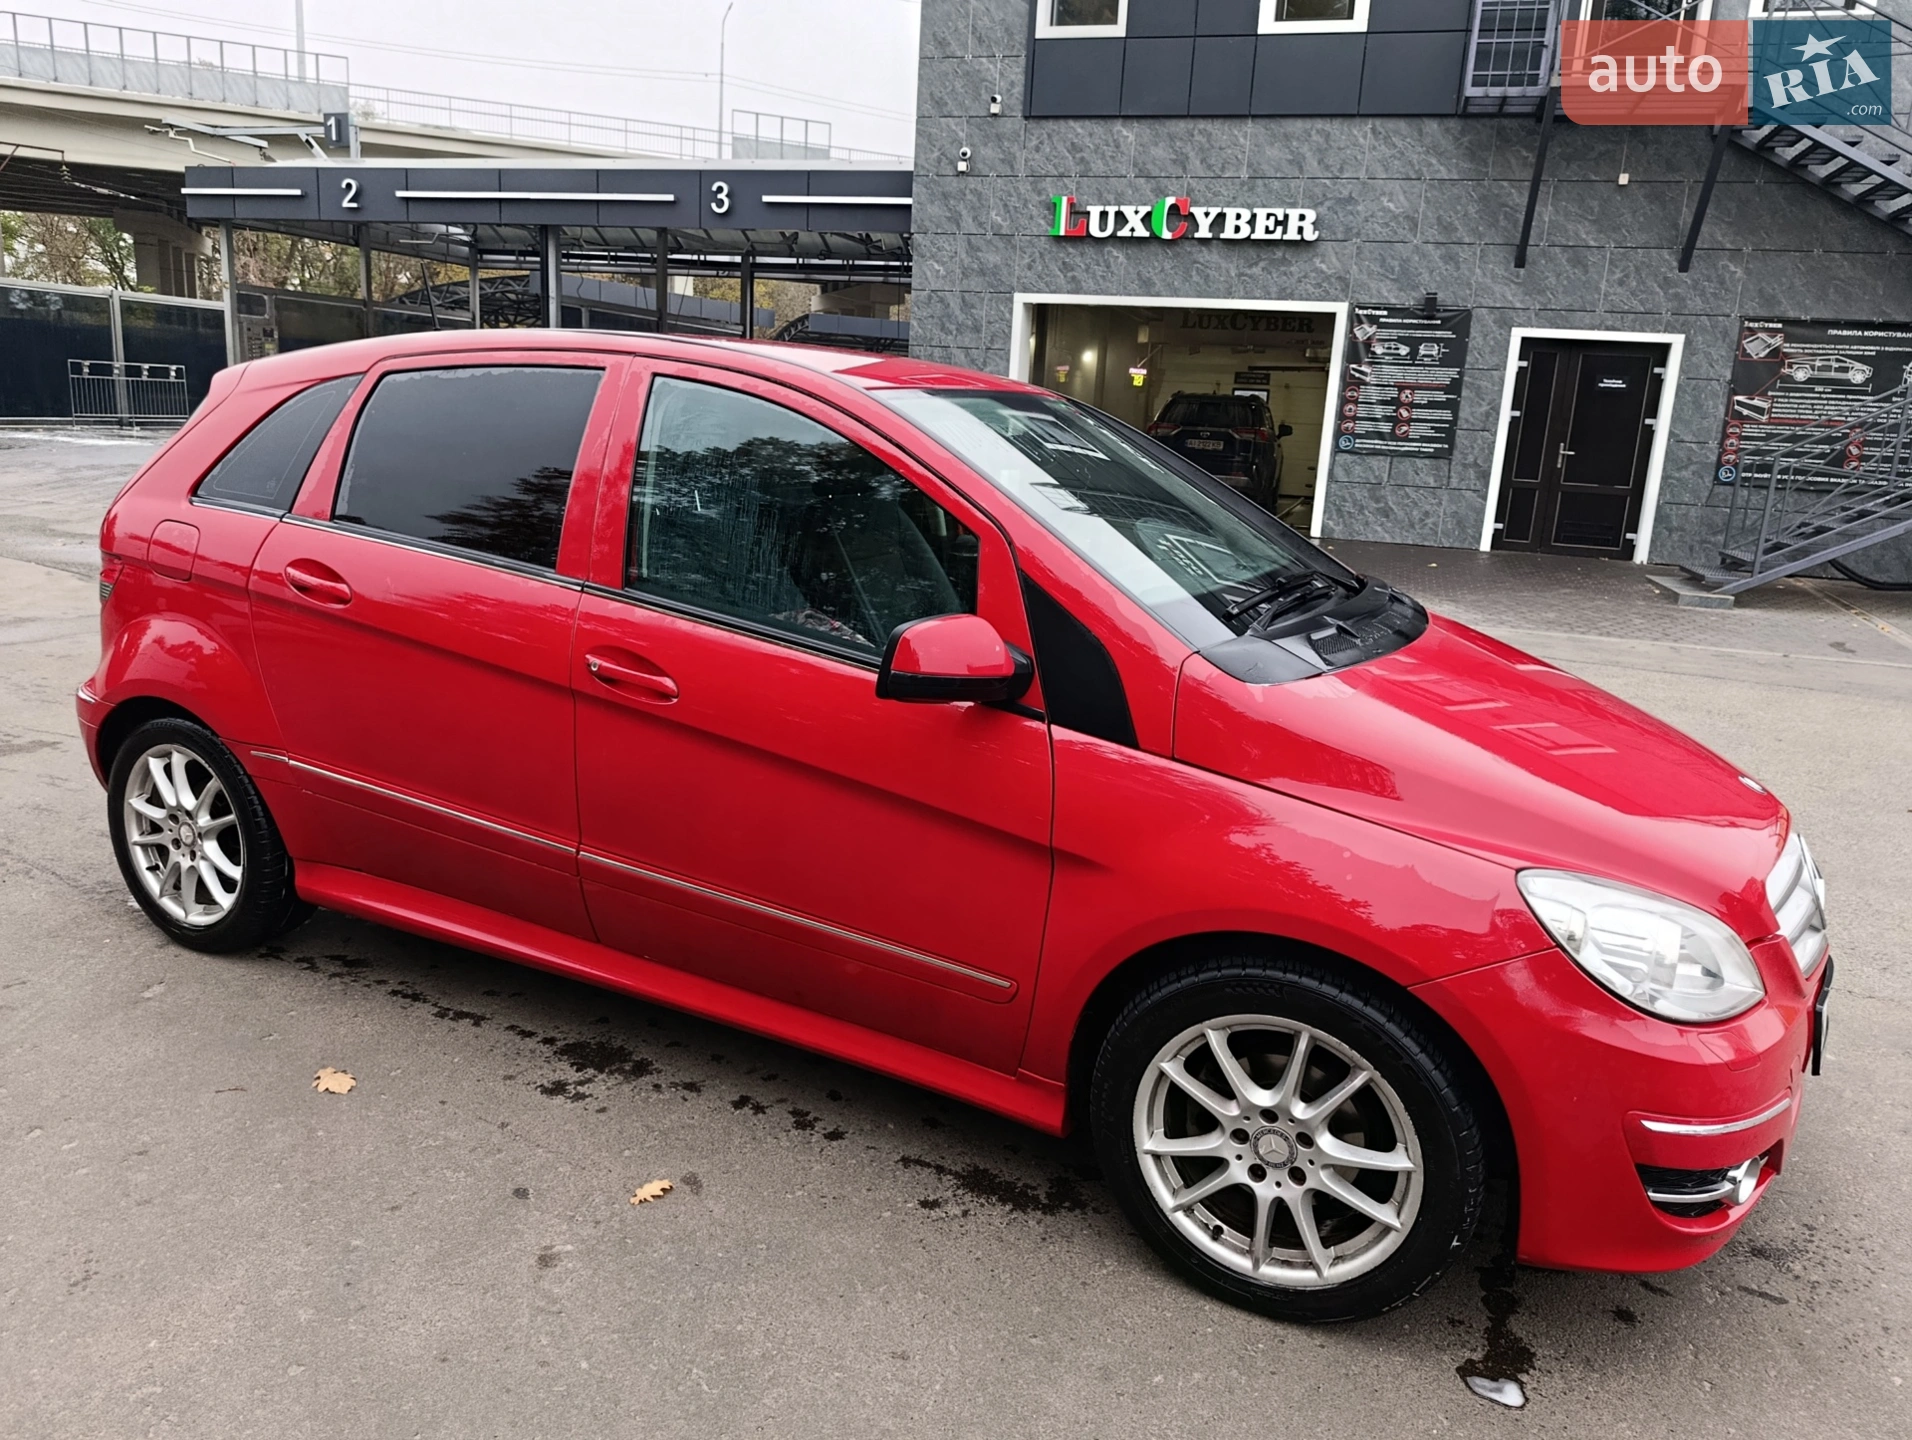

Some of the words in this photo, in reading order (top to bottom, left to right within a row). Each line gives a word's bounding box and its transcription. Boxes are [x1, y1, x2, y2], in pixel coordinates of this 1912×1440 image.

[326, 117, 338, 141] 1
[341, 178, 359, 208] 2
[711, 181, 731, 214] 3
[1827, 329, 1863, 337] ПРАВИЛА
